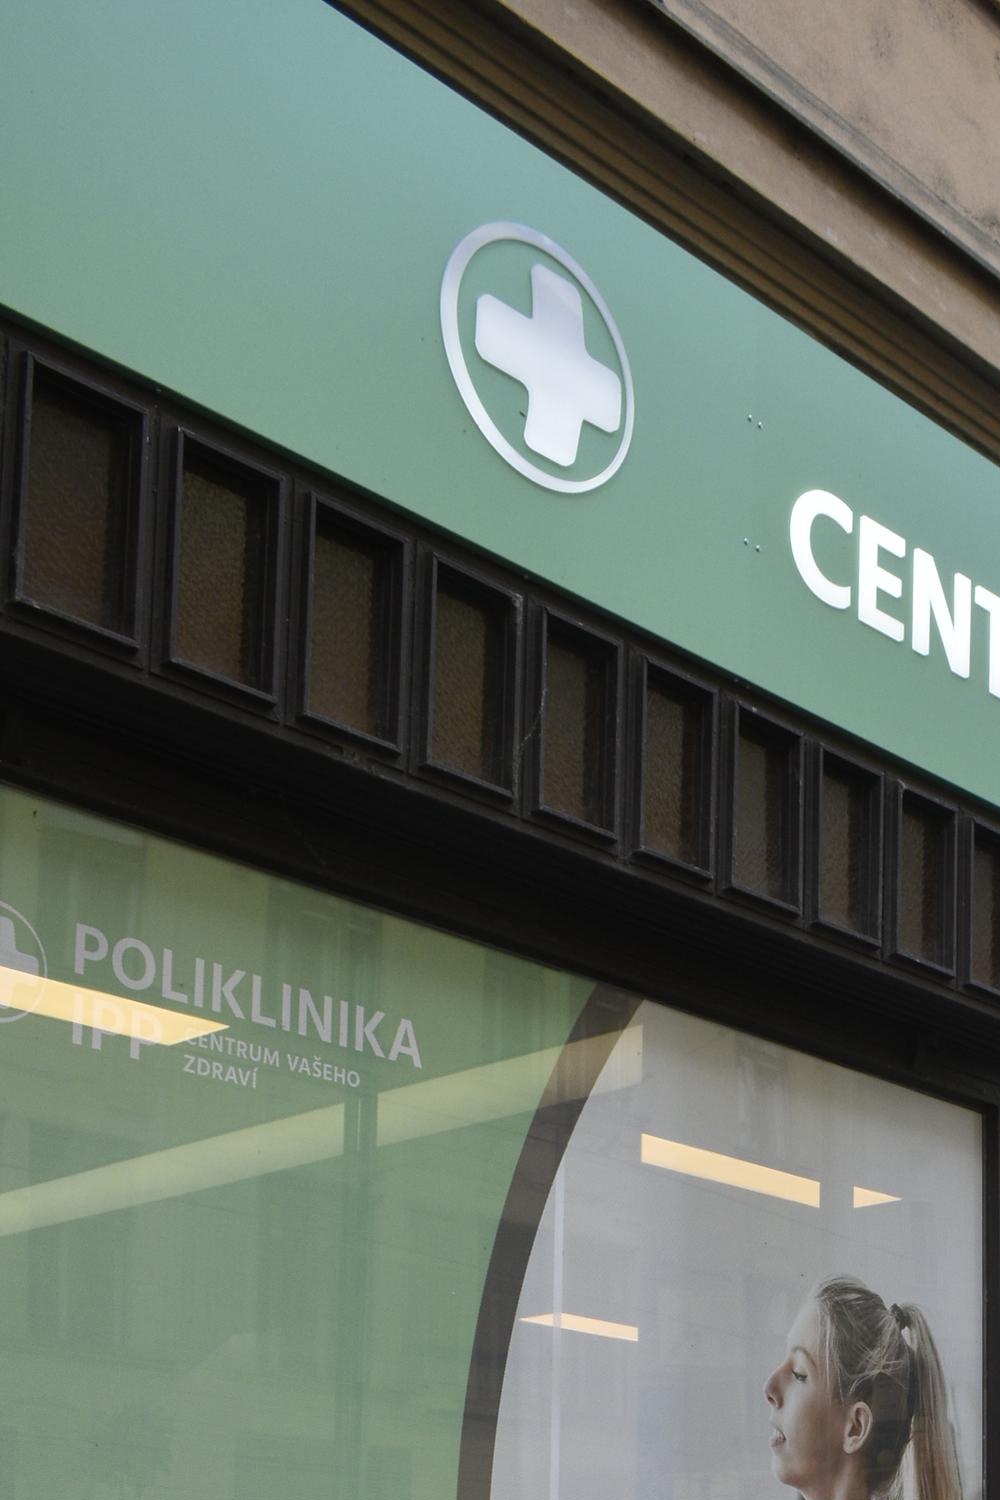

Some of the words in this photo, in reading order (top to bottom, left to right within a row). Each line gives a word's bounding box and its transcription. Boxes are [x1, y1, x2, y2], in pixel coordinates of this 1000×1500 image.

[72, 992, 162, 1060] IPP
[74, 923, 422, 1068] POLIKLINIKA
[183, 1054, 258, 1089] ZDRAVÍ
[187, 1029, 280, 1068] CENTRUM
[287, 1054, 361, 1088] VAŠEHO
